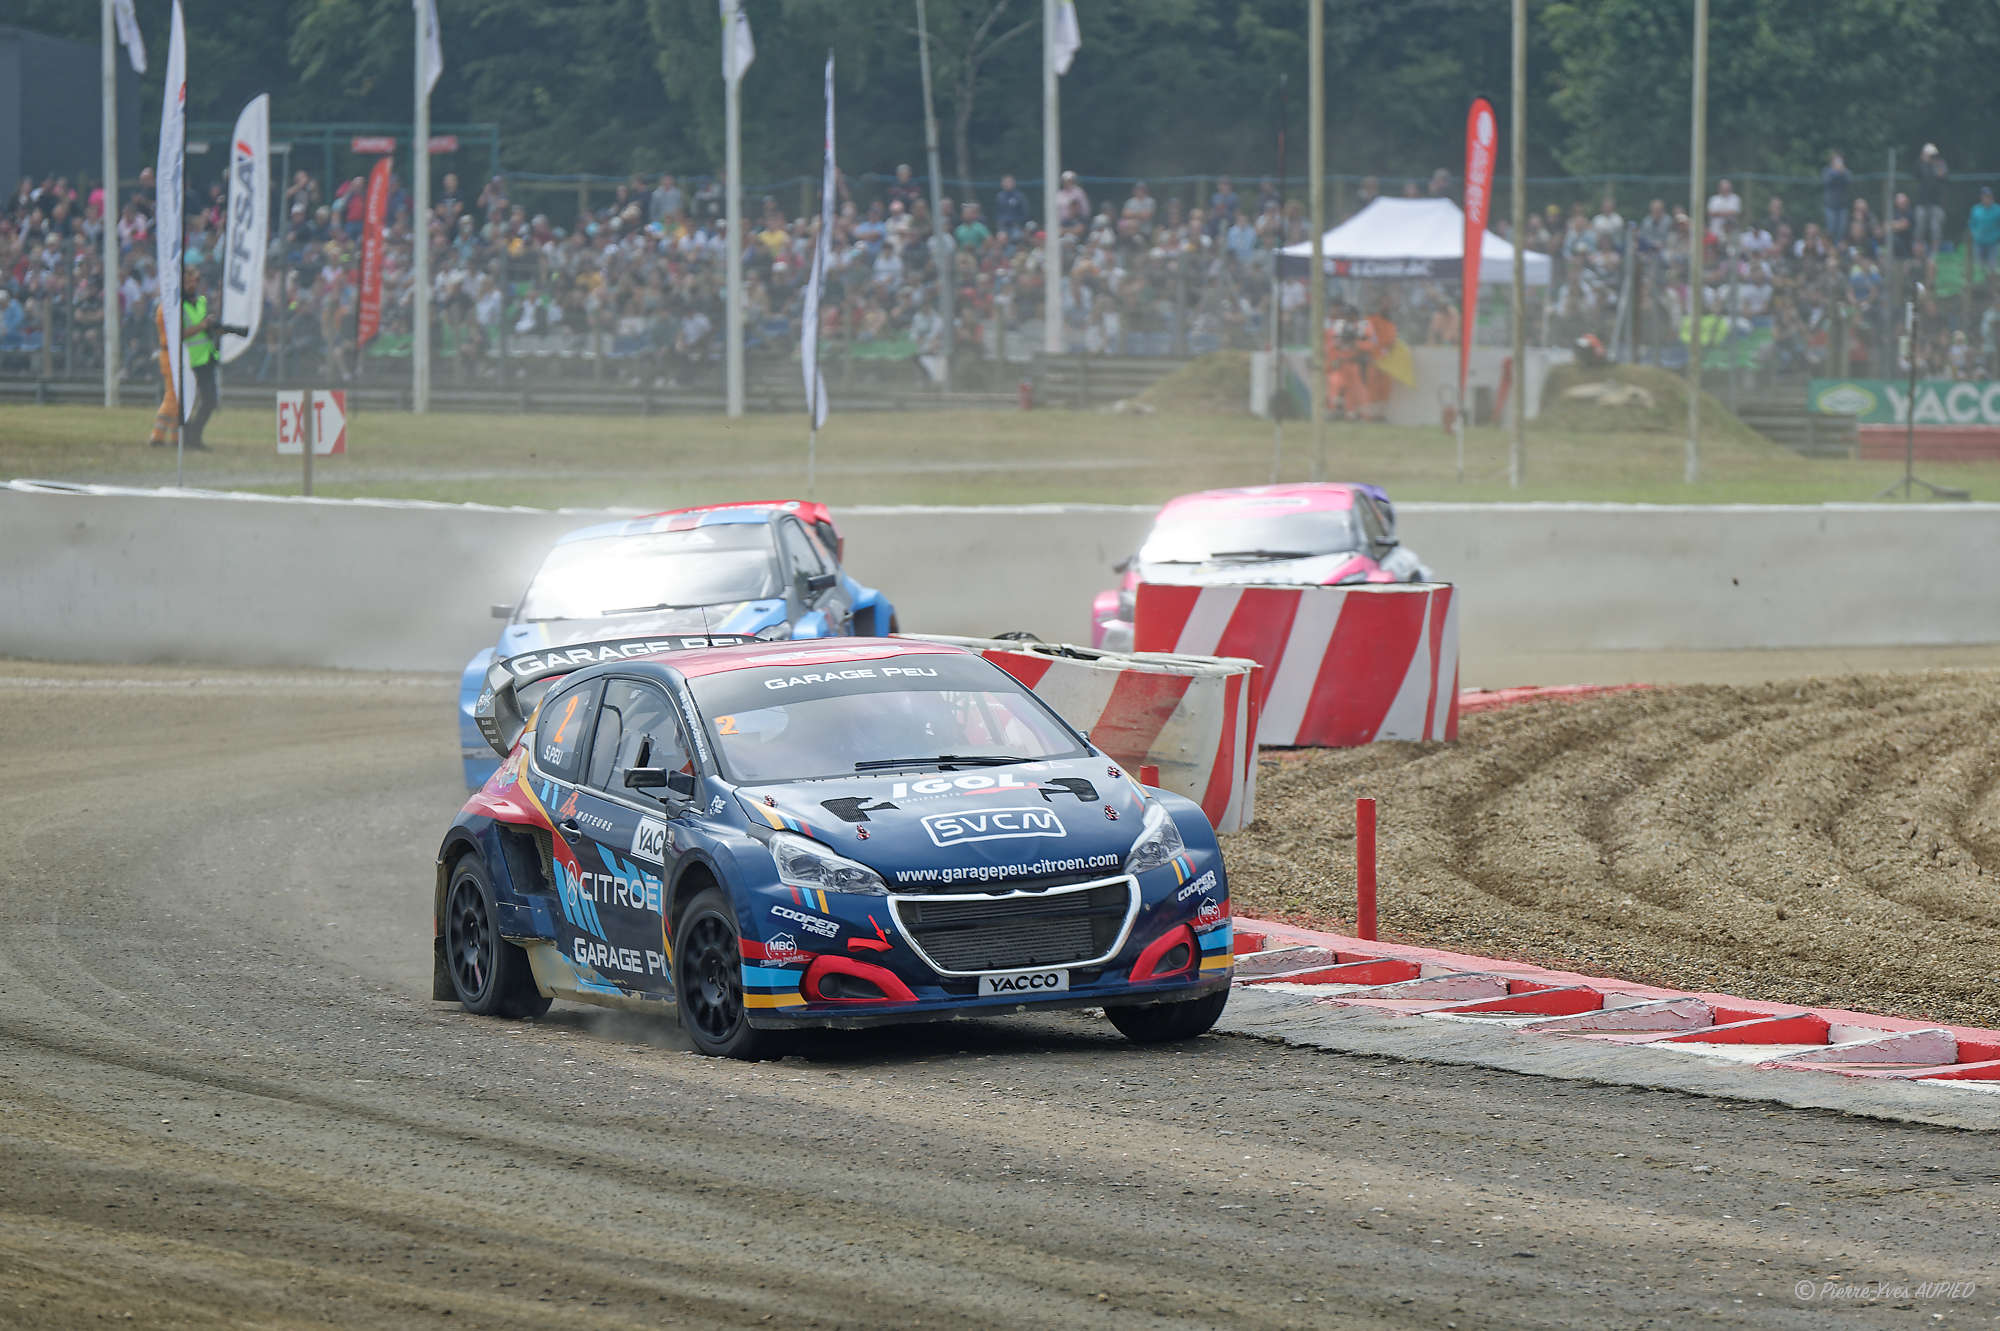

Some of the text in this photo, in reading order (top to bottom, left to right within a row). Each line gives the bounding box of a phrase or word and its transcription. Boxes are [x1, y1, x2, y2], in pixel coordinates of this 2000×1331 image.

[229, 155, 254, 294] FFSA
[279, 401, 325, 443] EXT
[510, 640, 670, 676] GARAGE
[764, 667, 939, 690] GARAGE PEU
[553, 695, 579, 744] 2
[714, 715, 740, 735] 2
[892, 773, 1025, 799] IGOL
[575, 810, 613, 832] MOTEURS
[896, 852, 1119, 884] www.garagepeu-citroen.com
[1178, 870, 1215, 902] COOPER
[770, 905, 841, 933] COOPER
[801, 922, 837, 938] TIRES
[574, 937, 644, 973] GARAGE
[769, 941, 795, 951] MBC
[988, 973, 1059, 992] YACCO
